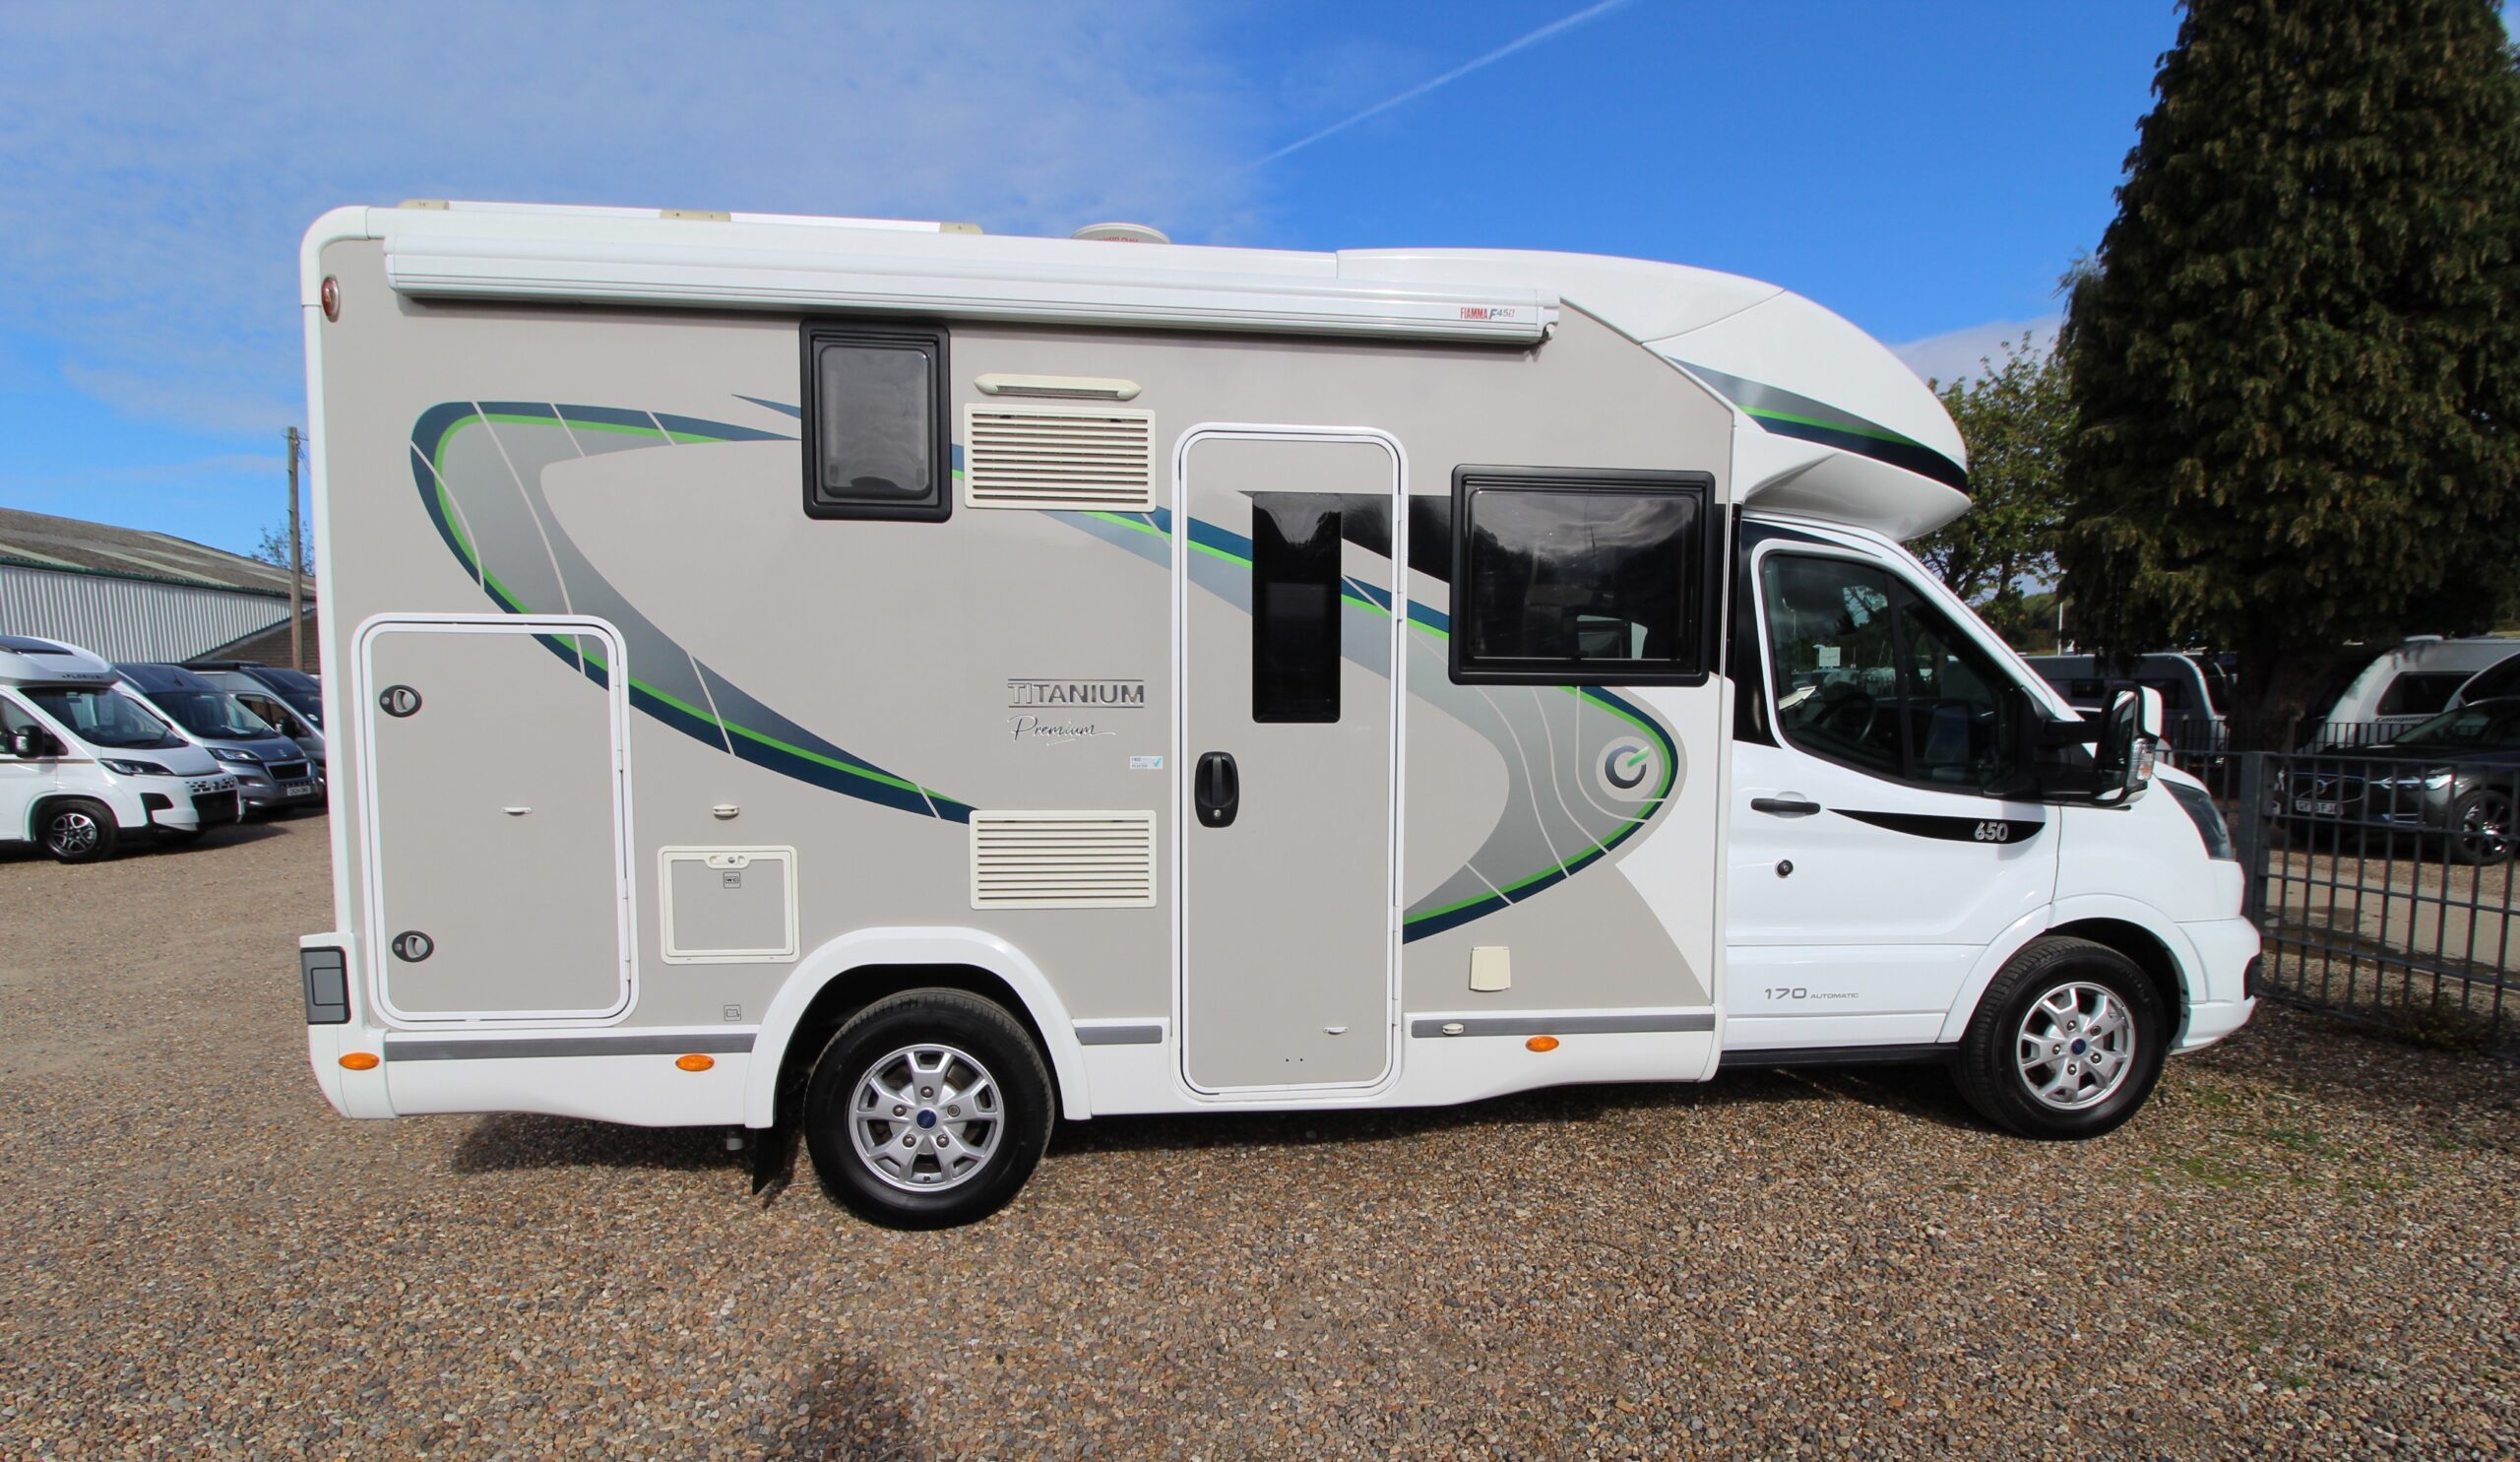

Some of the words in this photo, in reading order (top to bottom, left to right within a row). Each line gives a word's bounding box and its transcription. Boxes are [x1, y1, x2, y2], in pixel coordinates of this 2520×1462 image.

[1460, 307, 1488, 320] FIAMMA
[1008, 682, 1144, 704] TITANIUM
[1007, 714, 1115, 743] Premium
[1975, 821, 2008, 841] 650
[1765, 987, 1807, 999] 170
